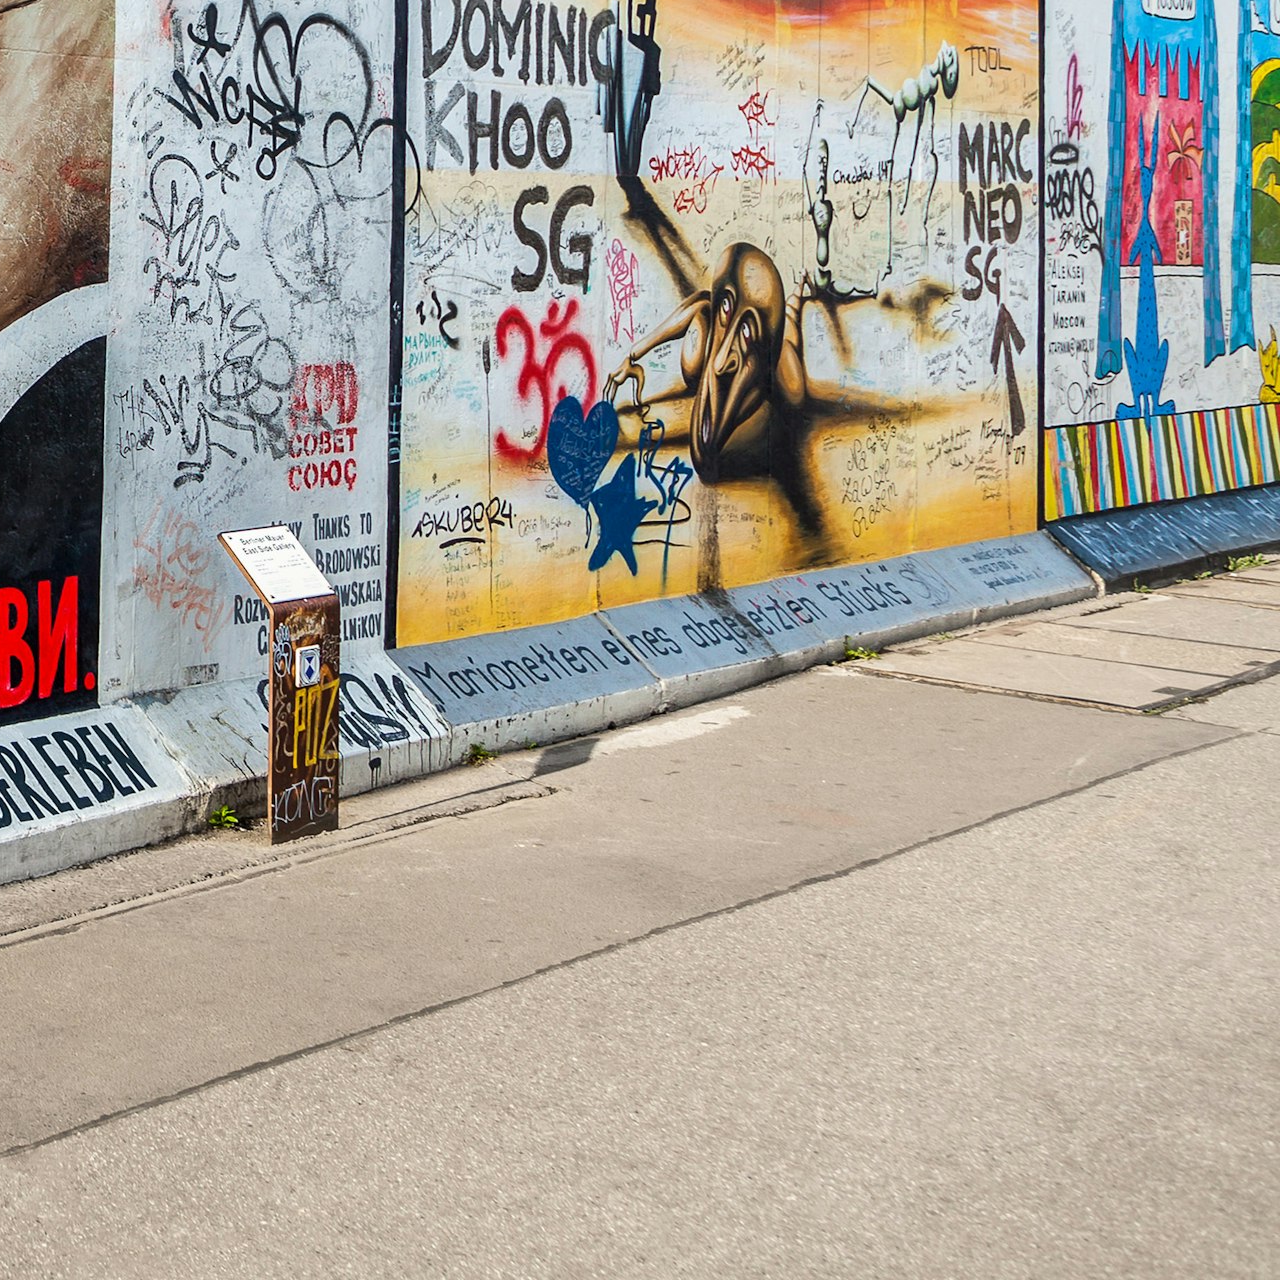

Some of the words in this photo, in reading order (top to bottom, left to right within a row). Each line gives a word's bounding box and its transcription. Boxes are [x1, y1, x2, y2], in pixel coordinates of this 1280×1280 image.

[424, 79, 573, 176] KHOO
[959, 118, 1033, 195] MARC
[511, 185, 595, 295] SG
[962, 183, 1023, 245] NEO
[289, 427, 358, 459] СОВЕТ
[313, 513, 350, 540] THANKS
[360, 512, 372, 535] TO
